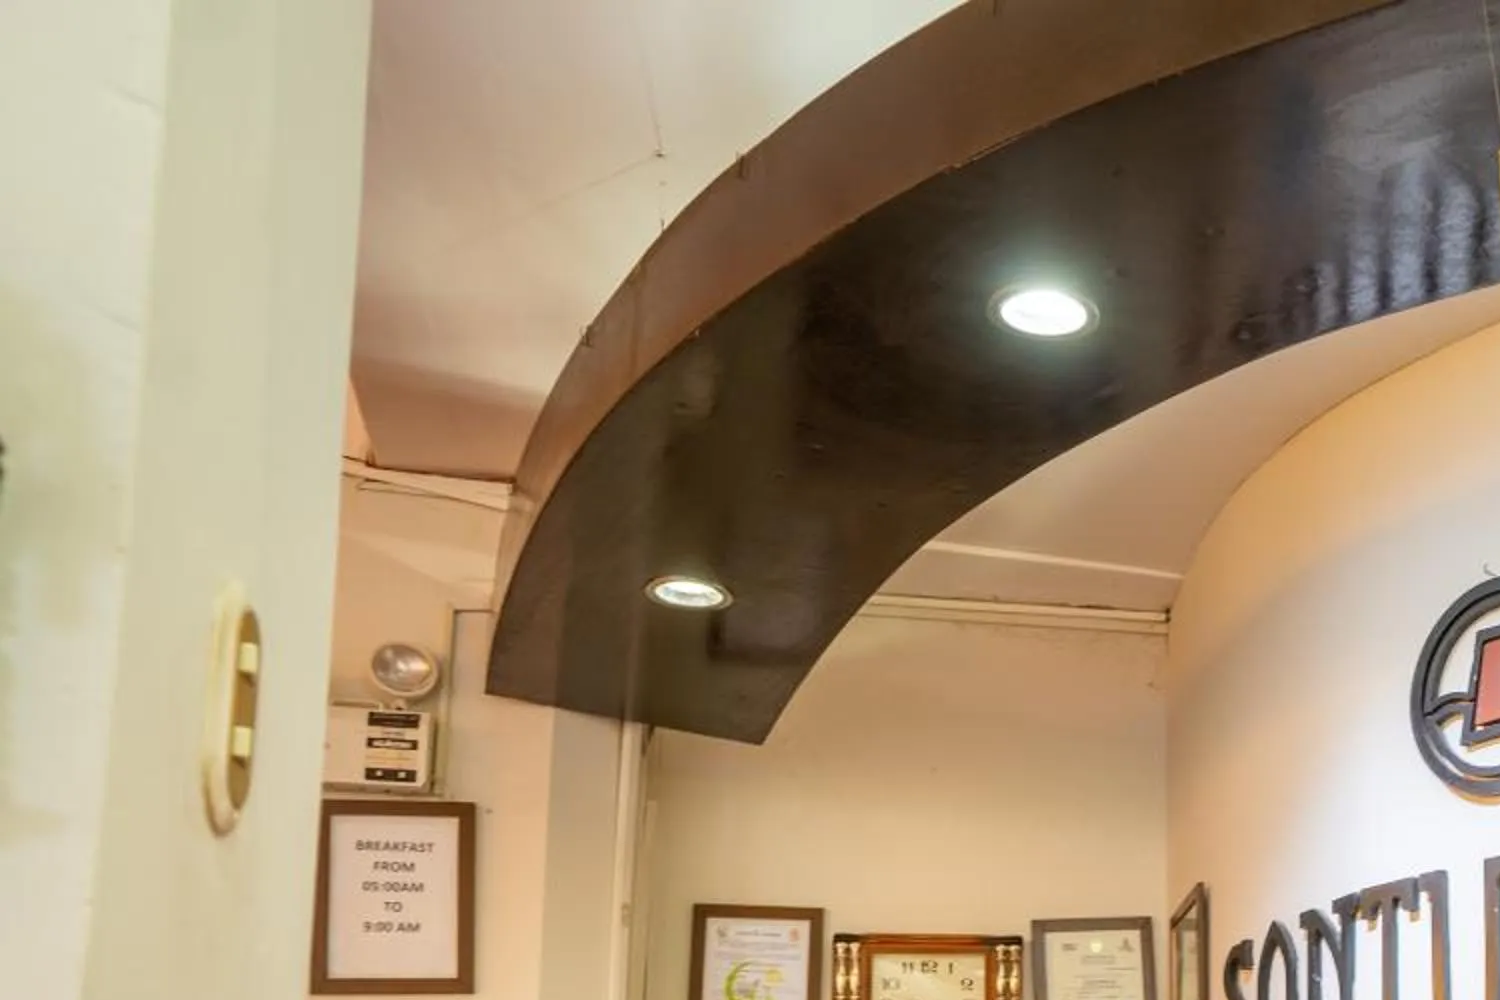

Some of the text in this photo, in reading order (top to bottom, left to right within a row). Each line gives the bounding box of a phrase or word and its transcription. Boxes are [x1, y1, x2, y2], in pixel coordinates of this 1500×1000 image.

[355, 839, 434, 853] BREAKFAST
[373, 860, 415, 873] FROM
[383, 901, 402, 913] TO
[362, 920, 420, 933] 9:00 AM
